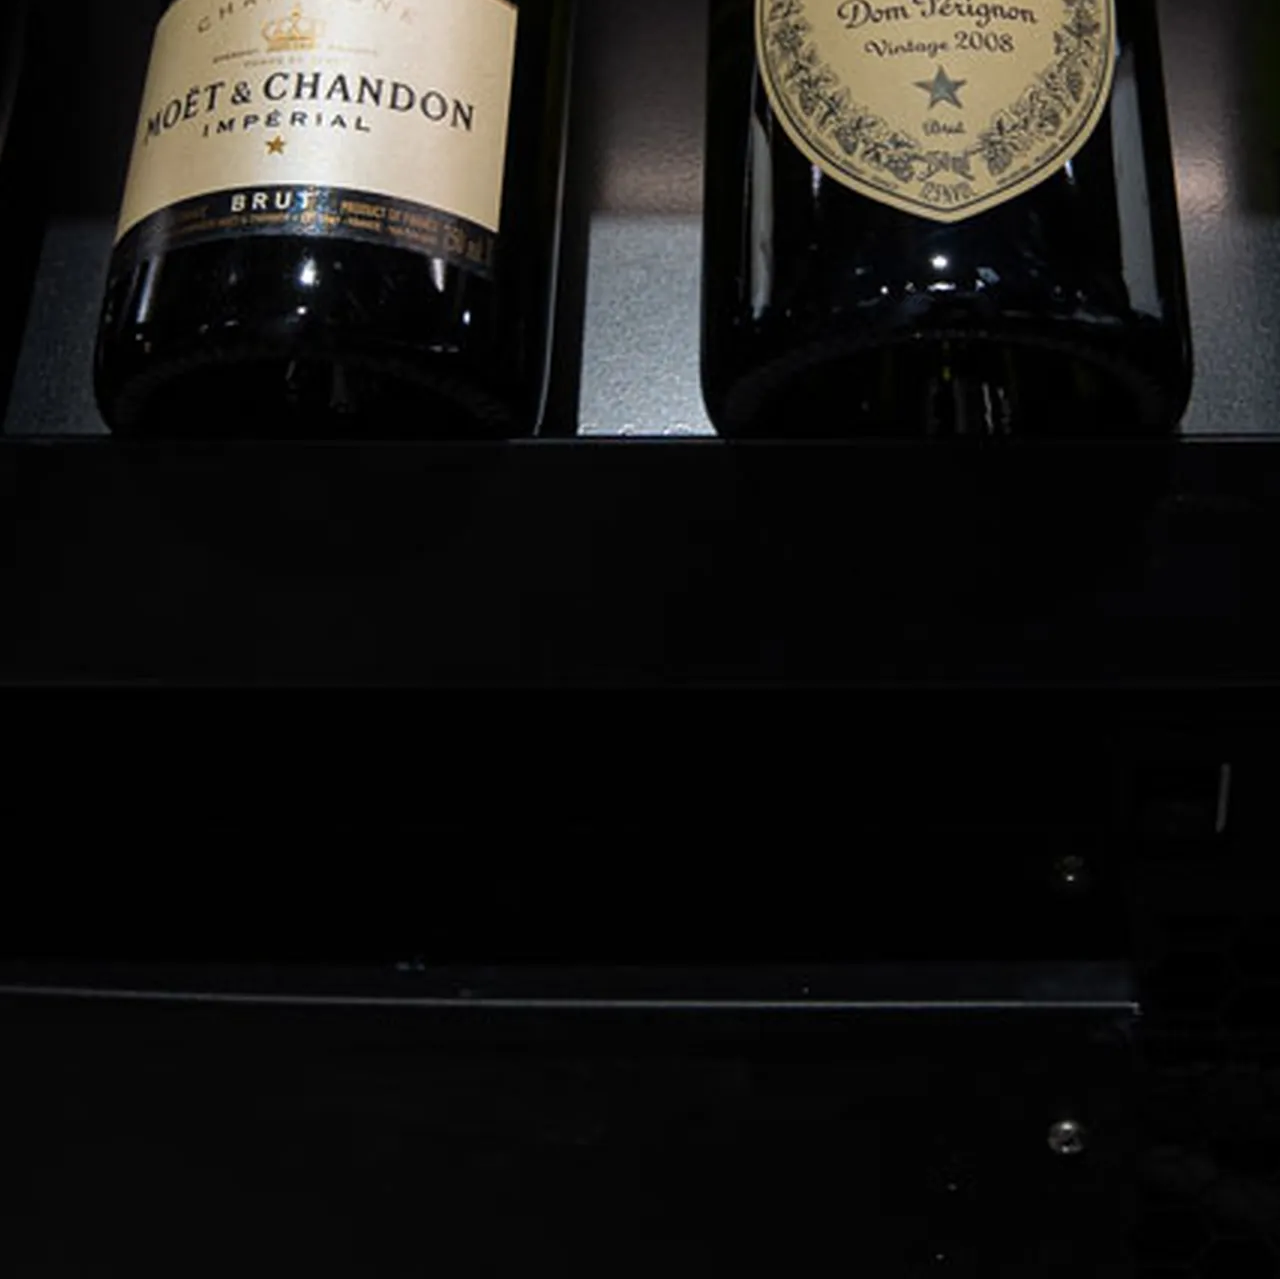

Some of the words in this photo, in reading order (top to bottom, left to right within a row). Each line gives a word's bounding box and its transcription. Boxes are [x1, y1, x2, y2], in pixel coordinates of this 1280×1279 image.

[863, 38, 950, 59] Vintage
[954, 30, 1015, 54] 2008
[142, 80, 226, 144] MOËT
[230, 80, 253, 107] &
[262, 70, 476, 133] CHANDON
[201, 108, 372, 139] IMPÉRIAL
[230, 191, 315, 213] BRUT
